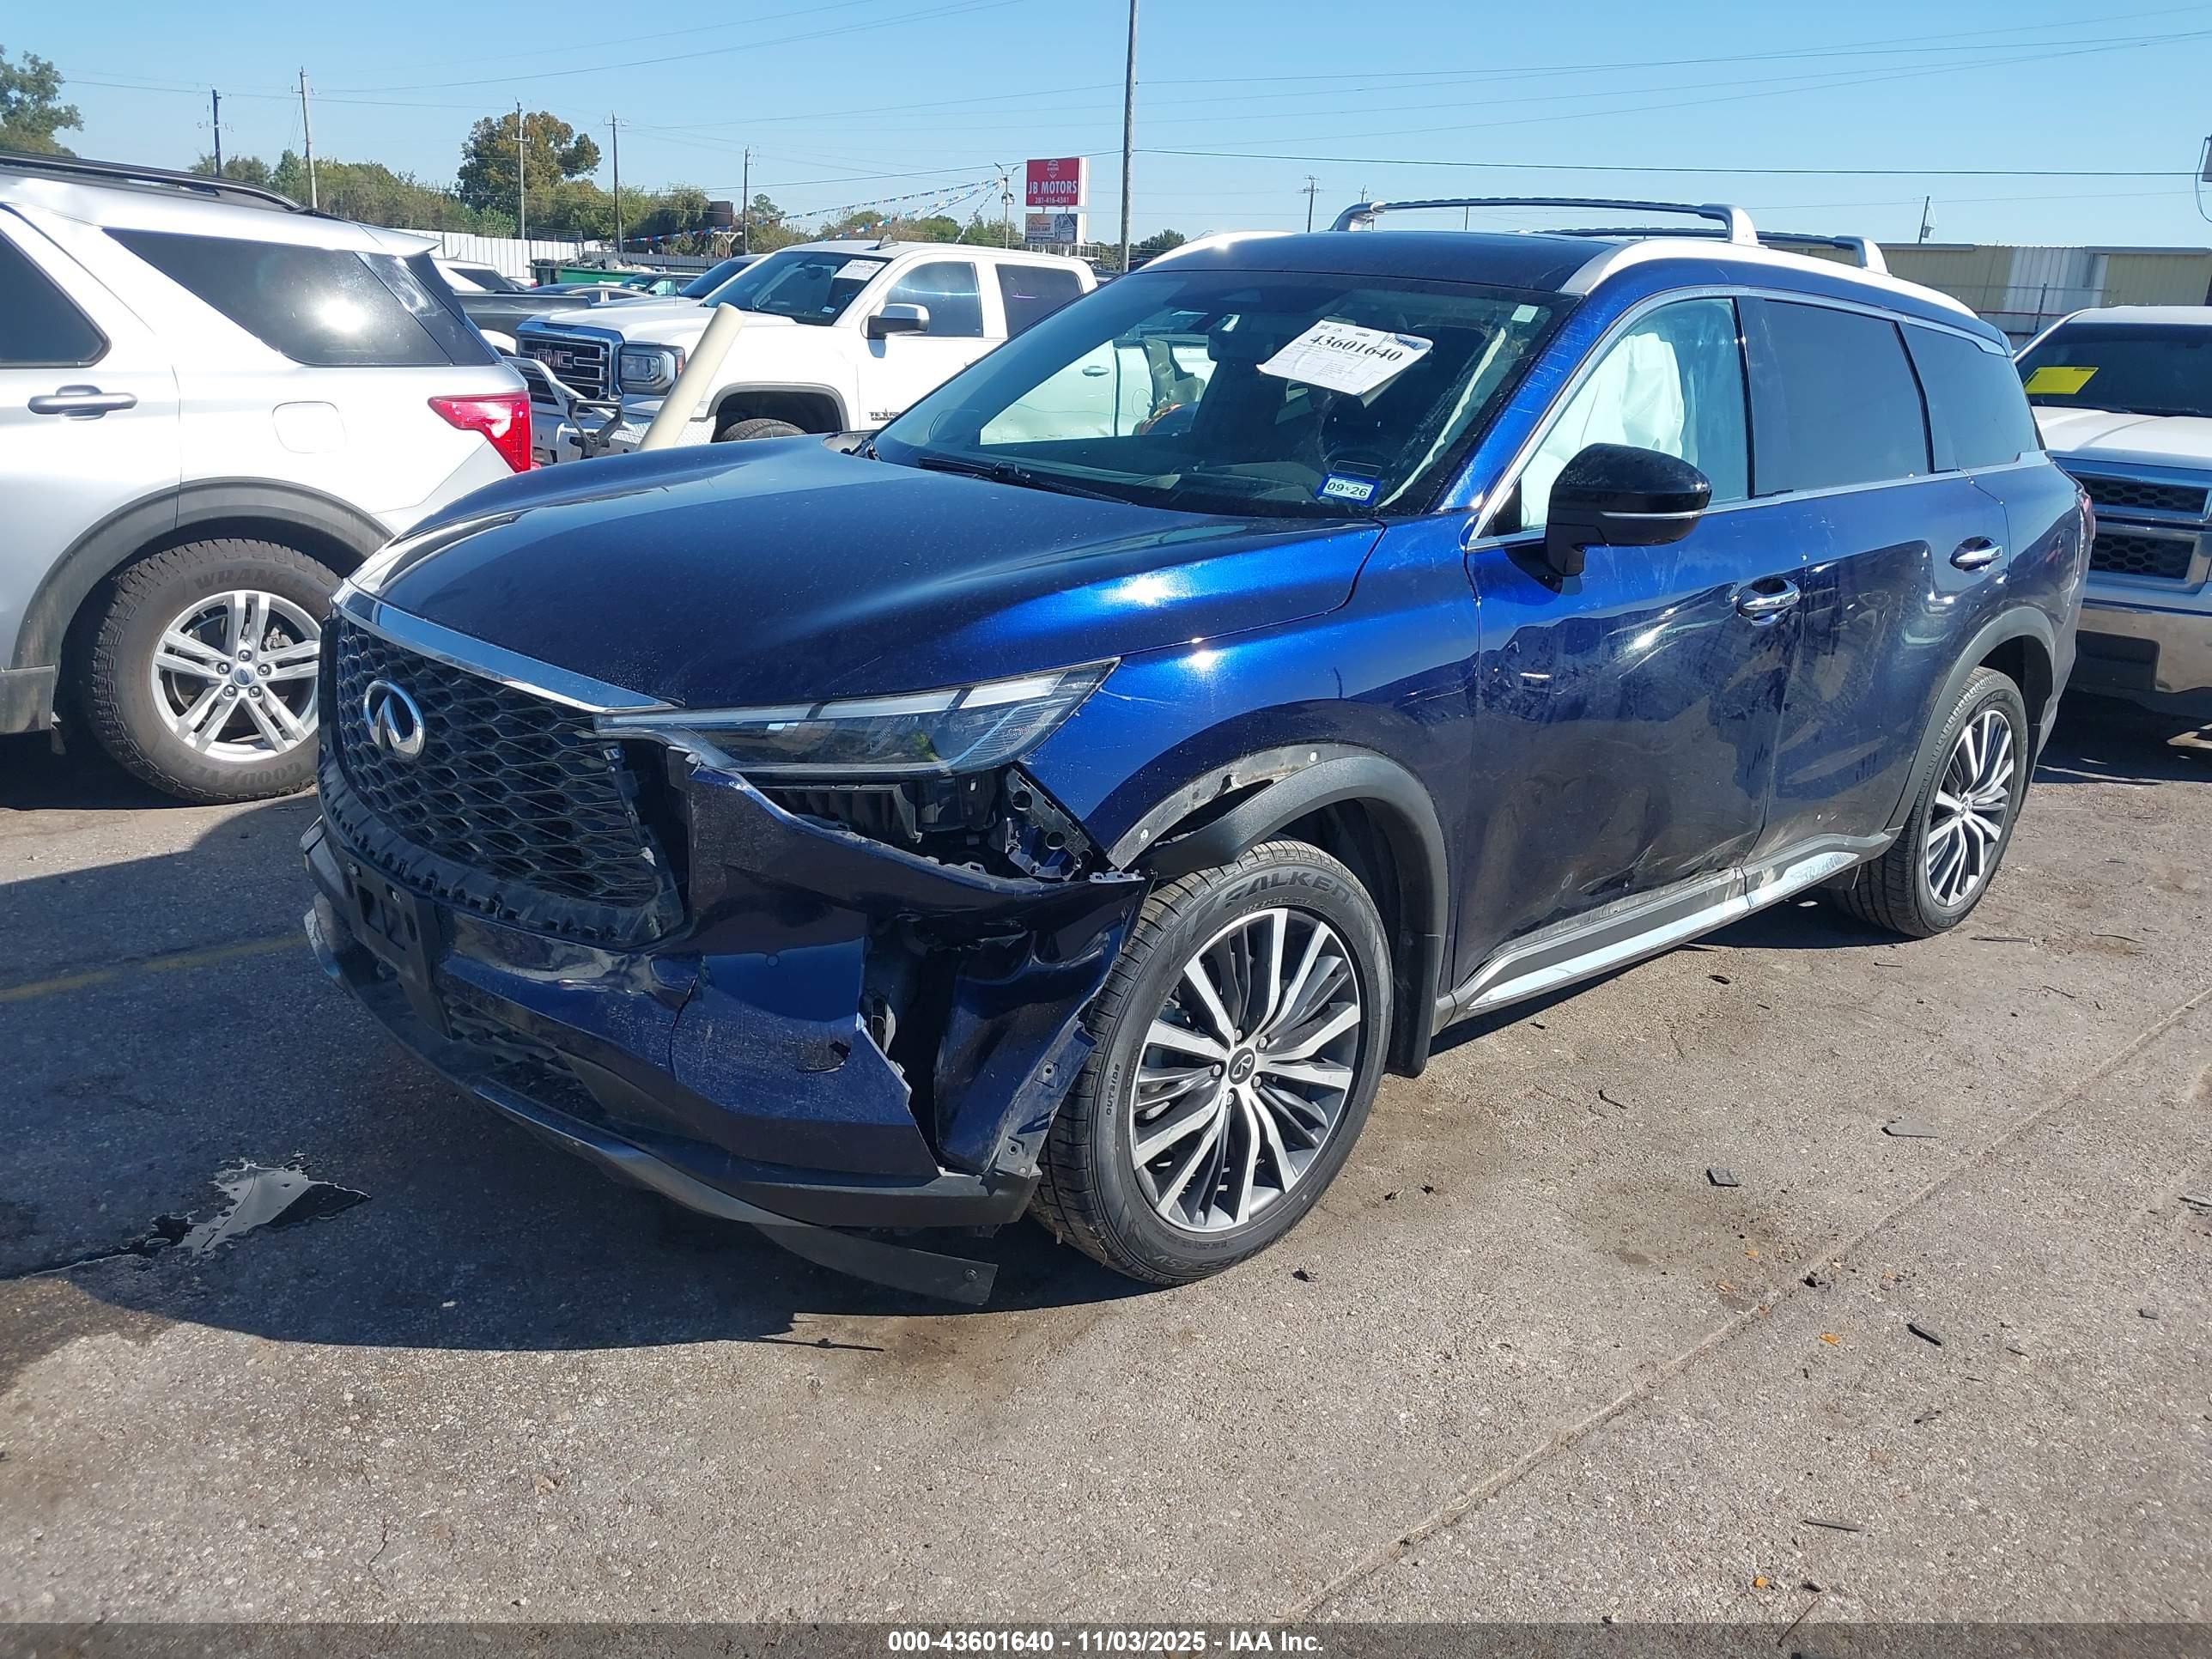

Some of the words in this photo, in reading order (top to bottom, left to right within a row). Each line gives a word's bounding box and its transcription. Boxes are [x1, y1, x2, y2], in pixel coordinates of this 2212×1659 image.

[1029, 181, 1038, 194] JB
[1041, 180, 1078, 194] MOTORS
[536, 348, 573, 369] GMC
[1310, 334, 1404, 362] 43601640
[1328, 482, 1345, 492] 09
[1350, 486, 1369, 496] 26
[1224, 871, 1352, 907] FALKEN
[1106, 1063, 1121, 1115] OUTSIDE
